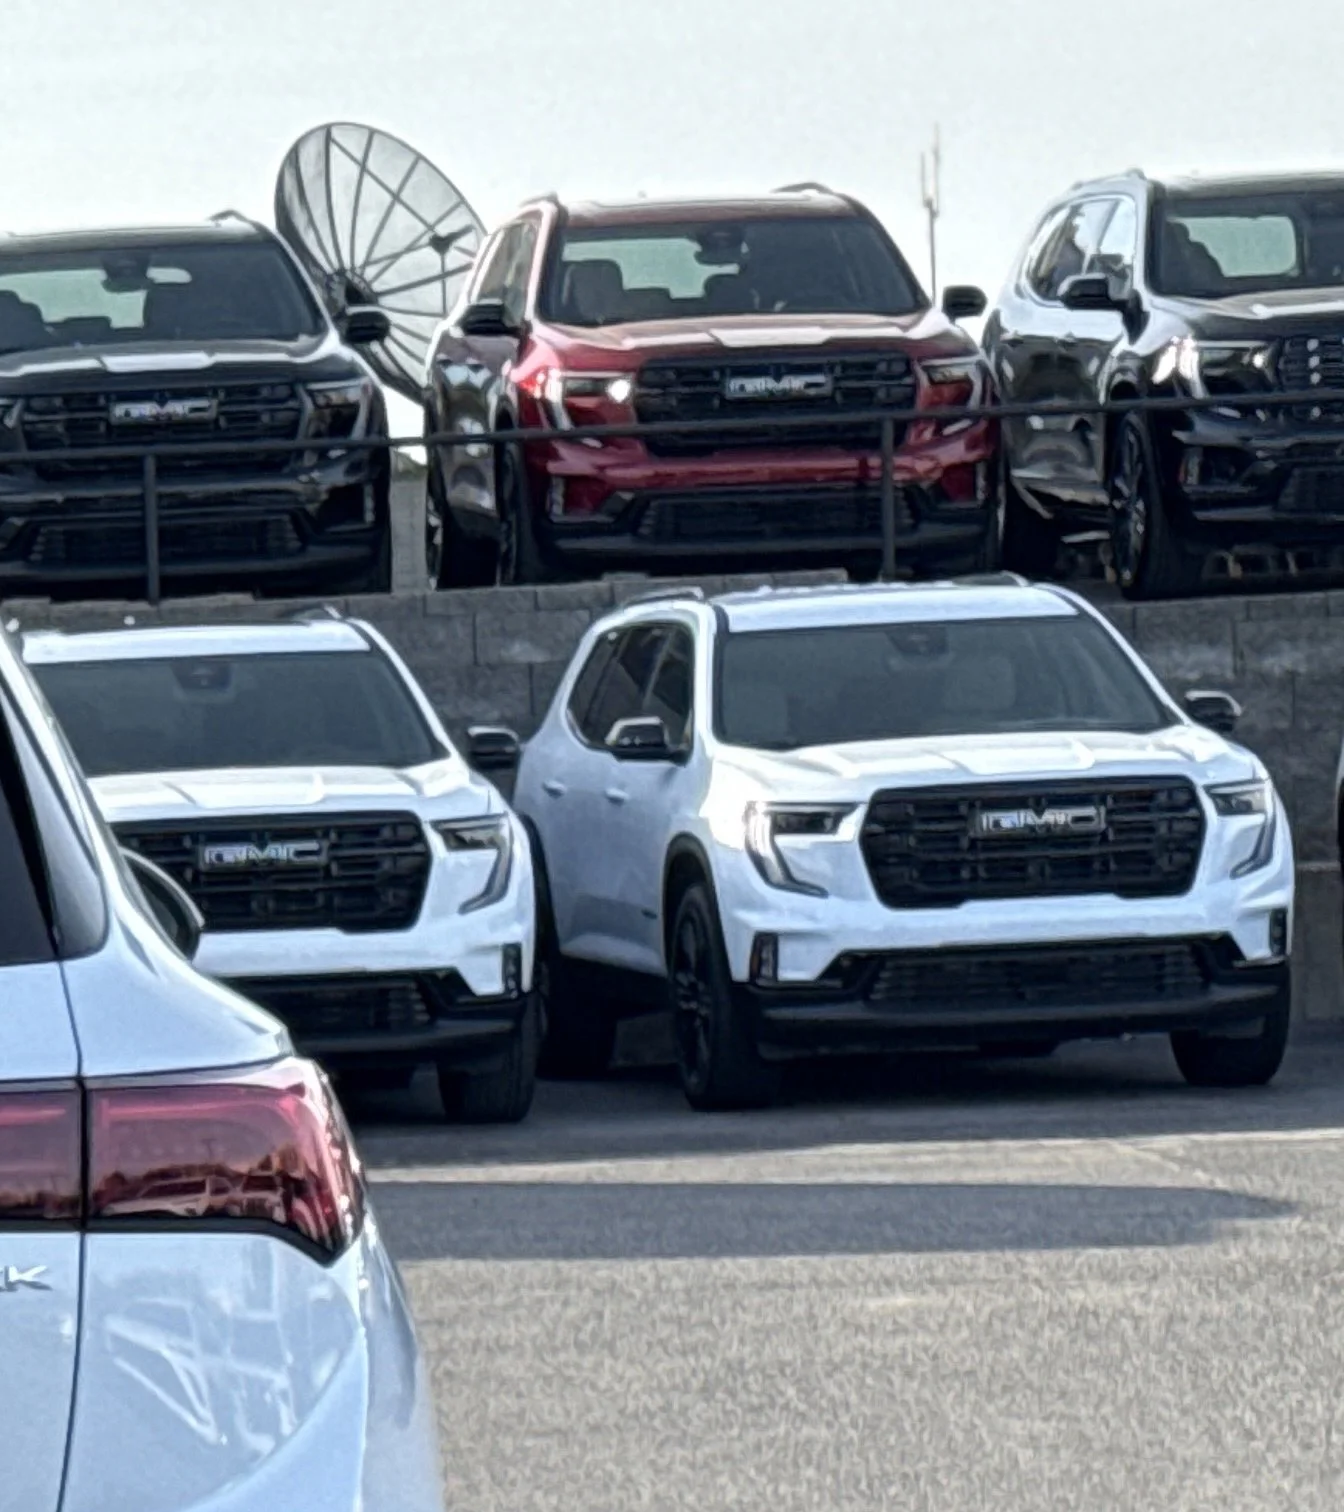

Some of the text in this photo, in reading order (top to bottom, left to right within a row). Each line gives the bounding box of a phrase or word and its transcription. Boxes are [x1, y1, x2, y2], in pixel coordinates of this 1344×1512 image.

[729, 374, 826, 396] GMC
[982, 806, 1097, 832] GMC
[205, 841, 320, 866] GMC
